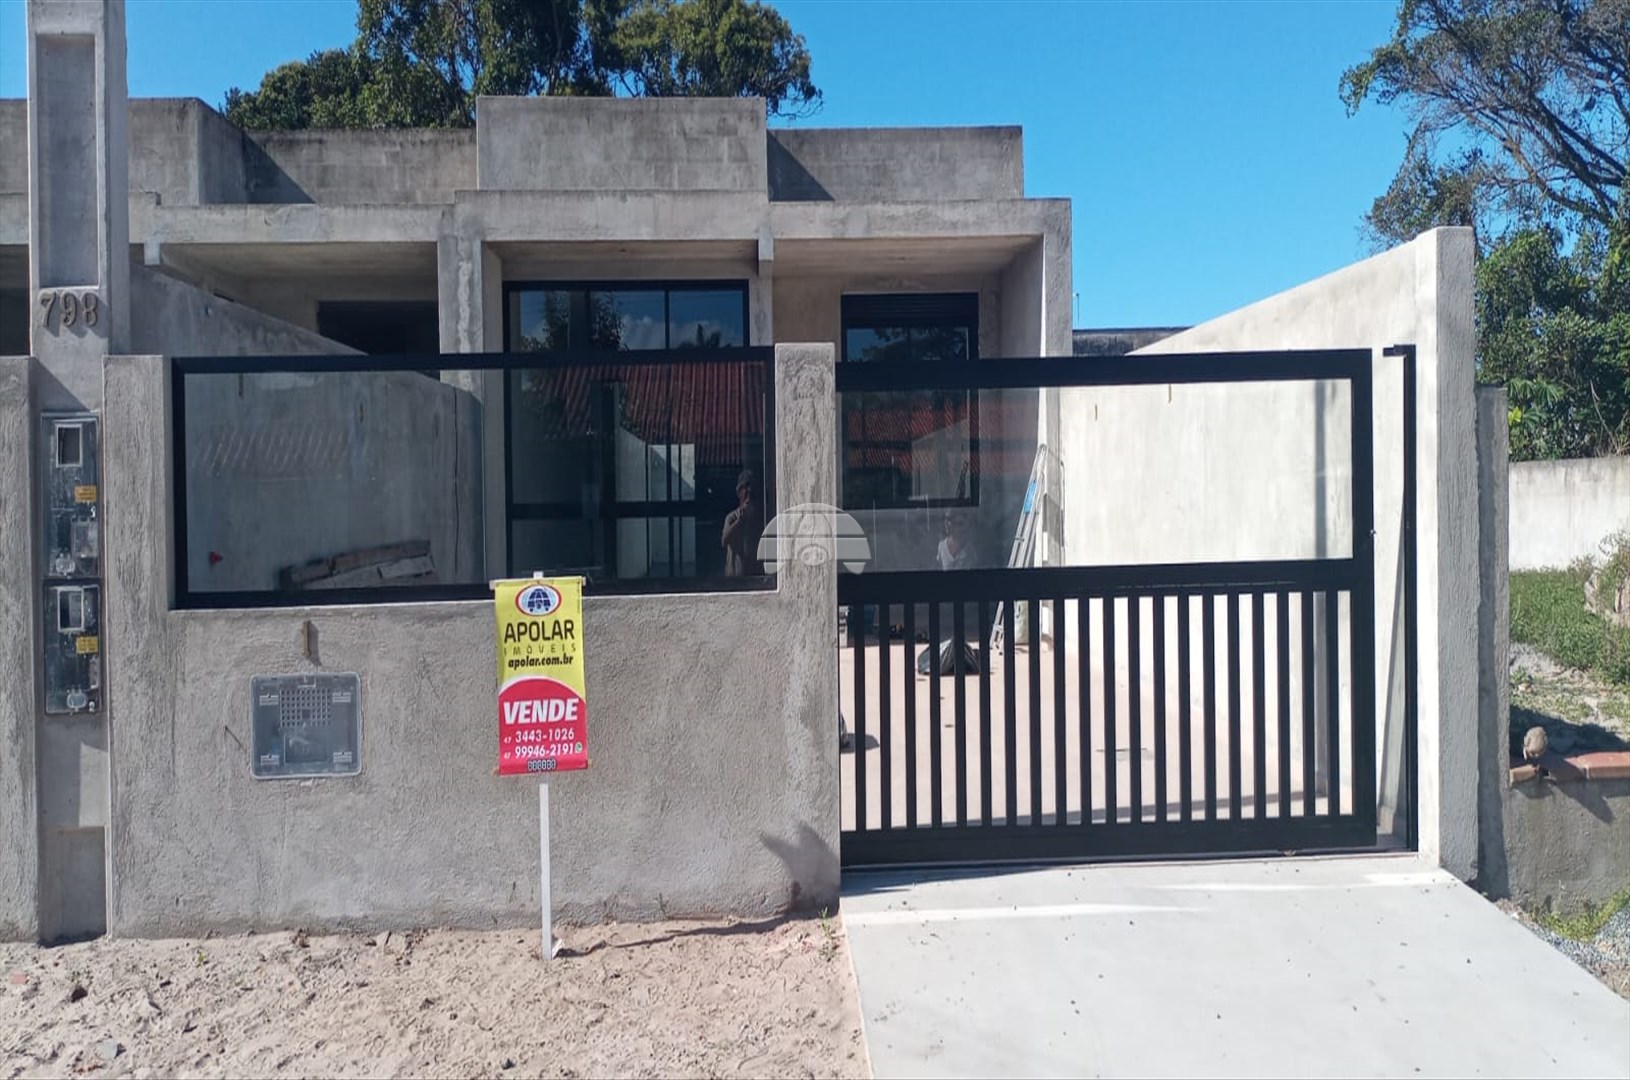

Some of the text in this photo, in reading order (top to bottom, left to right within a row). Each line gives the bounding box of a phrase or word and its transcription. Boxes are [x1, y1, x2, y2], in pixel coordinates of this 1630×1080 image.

[38, 288, 99, 328] 798
[503, 619, 575, 644] APOLAR
[503, 643, 576, 656] IMÓVEIS
[508, 653, 573, 670] apolar.com.br
[503, 698, 579, 725] VENDE
[515, 728, 575, 744] 3443-1026
[514, 743, 574, 759] 99946-2191
